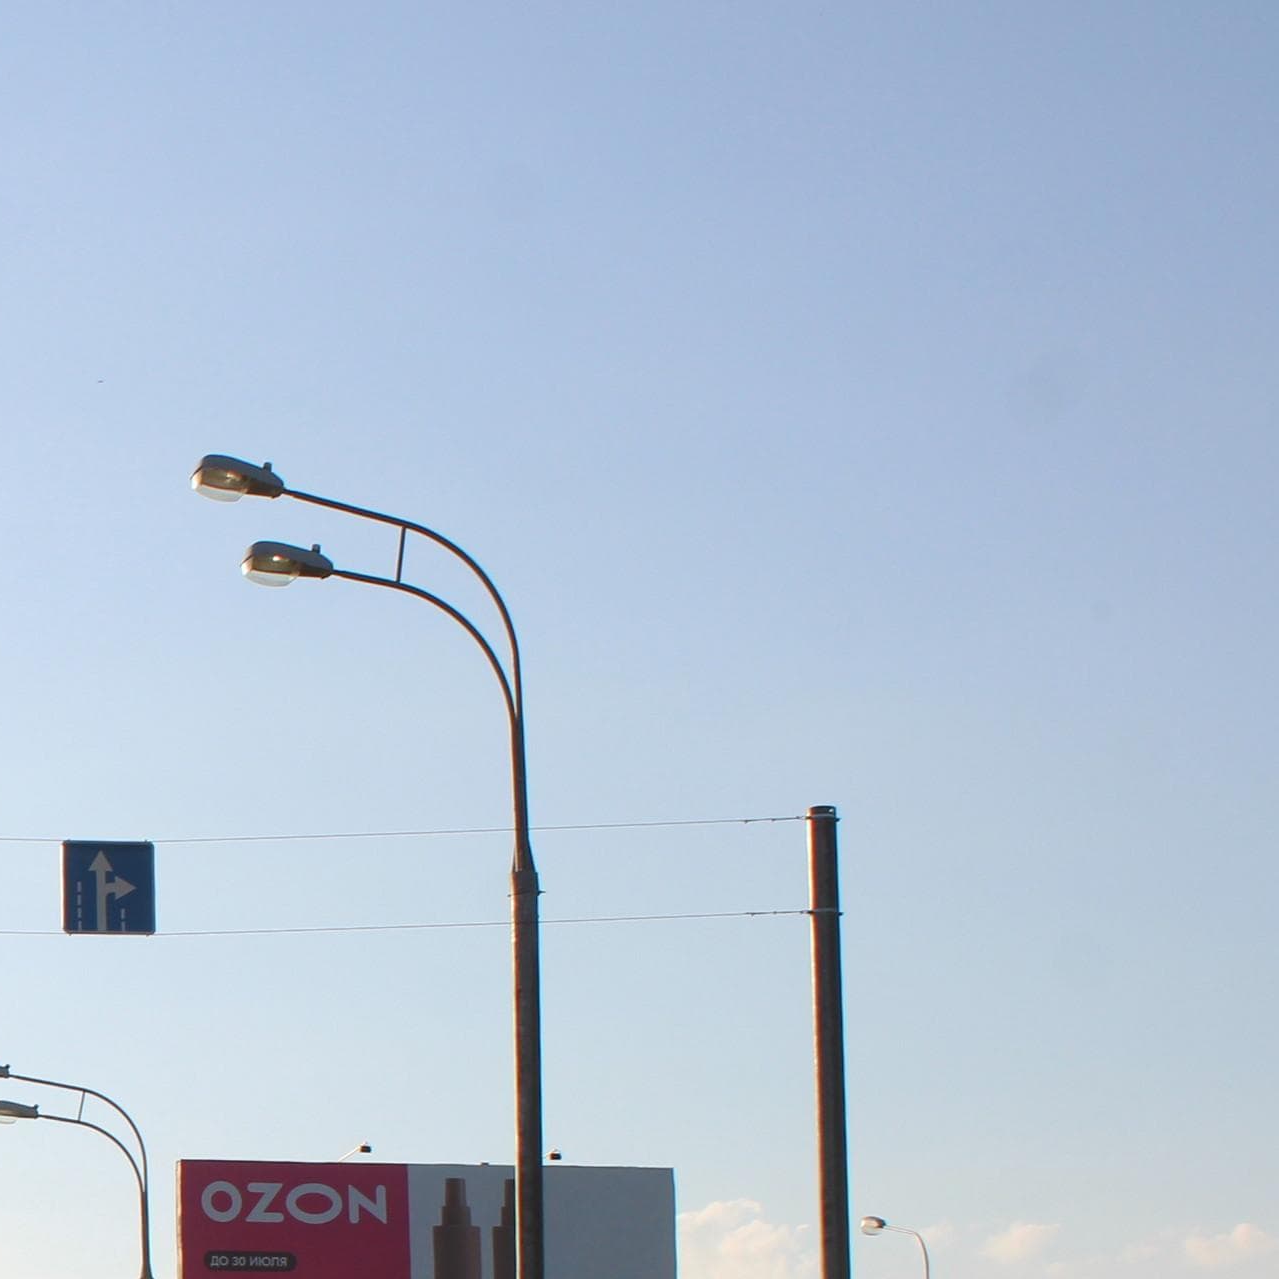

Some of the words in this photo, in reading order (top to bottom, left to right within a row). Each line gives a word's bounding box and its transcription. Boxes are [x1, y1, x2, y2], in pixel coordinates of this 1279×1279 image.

[201, 1180, 388, 1225] OZON
[210, 1256, 229, 1267] ДО
[233, 1256, 246, 1266] 30
[249, 1256, 287, 1267] ИЮЛЯ
